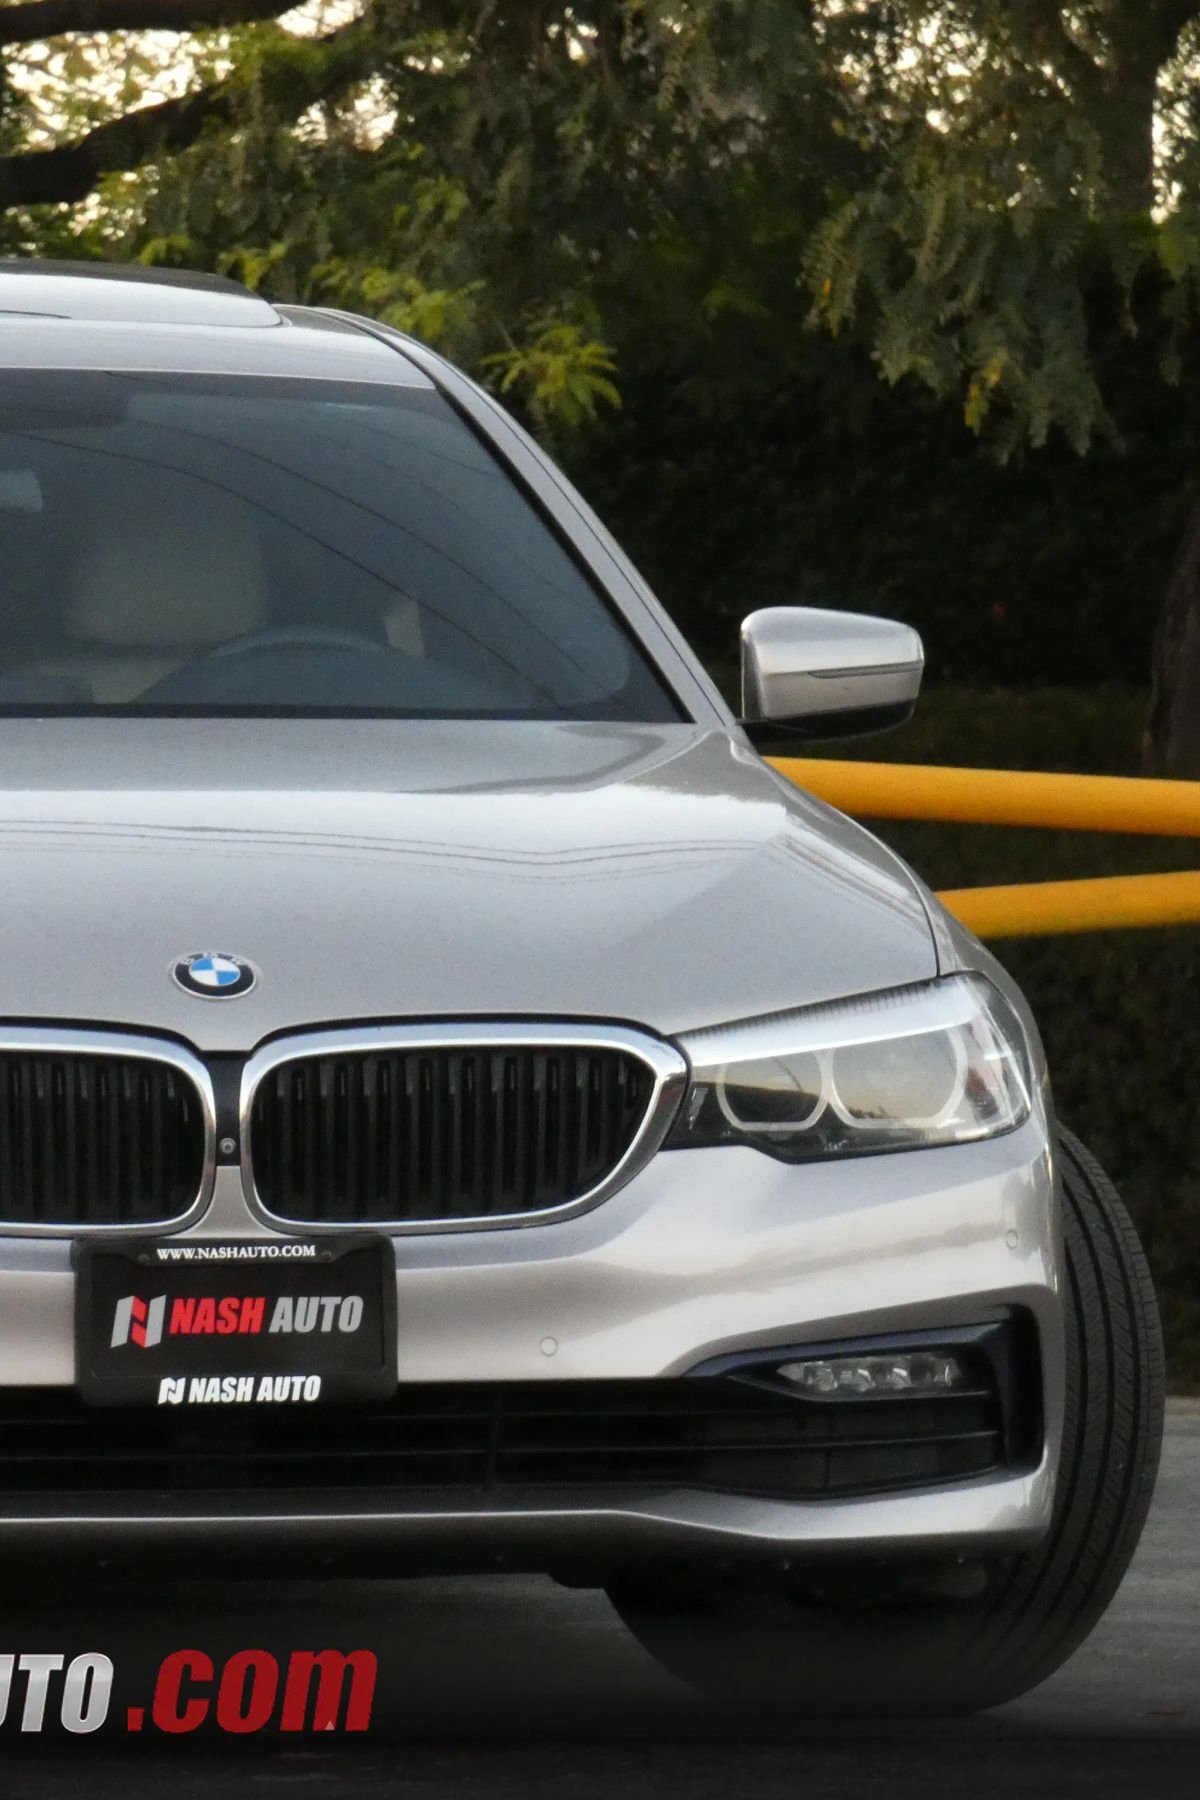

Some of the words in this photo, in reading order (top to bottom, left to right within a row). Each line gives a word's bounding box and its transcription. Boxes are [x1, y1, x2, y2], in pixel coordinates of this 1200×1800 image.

[157, 1245, 315, 1260] WWW.NASHAUTO.COM
[169, 1297, 266, 1334] NASH
[269, 1296, 363, 1333] AUTO
[188, 1377, 254, 1403] NASH
[256, 1375, 321, 1402] AUTO
